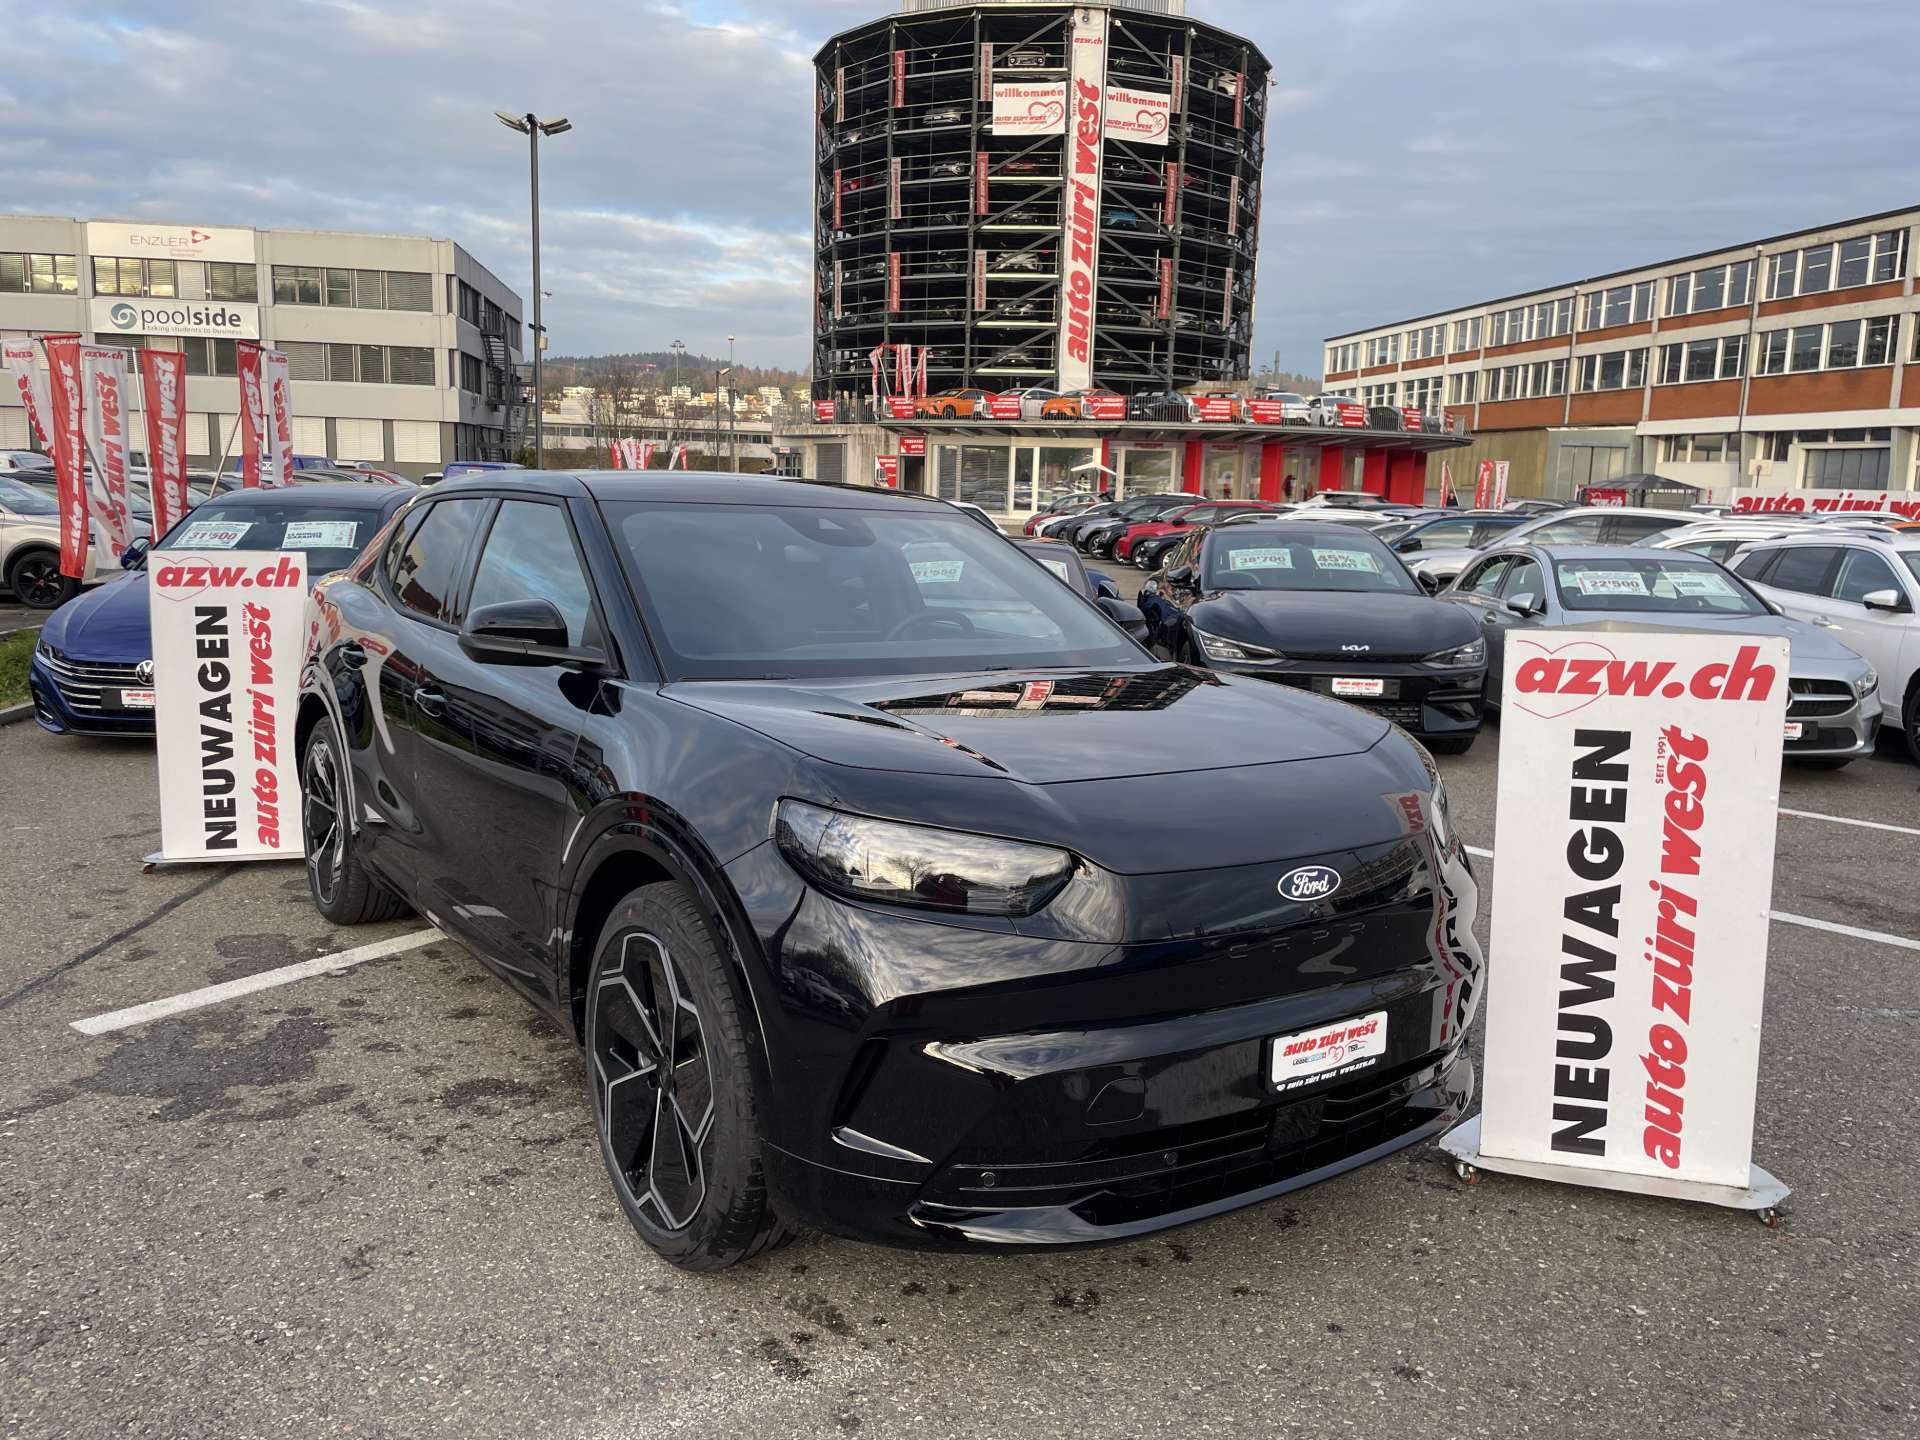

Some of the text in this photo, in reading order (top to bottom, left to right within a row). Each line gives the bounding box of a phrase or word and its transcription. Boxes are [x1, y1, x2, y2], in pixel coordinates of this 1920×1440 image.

[1074, 37, 1103, 45] azw.ch
[994, 88, 1065, 98] willkommen
[1107, 92, 1168, 109] willkommen
[1066, 78, 1100, 363] auto züri west
[130, 235, 189, 247] ENZLER
[141, 306, 242, 331] poolside
[147, 325, 170, 334] taking
[170, 326, 203, 335] students
[212, 328, 243, 336] business
[84, 350, 124, 360] azw.ch
[96, 371, 122, 436] west
[153, 355, 178, 419] west
[158, 420, 180, 481] züri
[100, 437, 126, 499] züri
[1811, 491, 1888, 512] züri
[156, 557, 300, 587] azw.ch
[1589, 580, 1640, 588] 22'500
[1515, 646, 1776, 701] azw.ch
[195, 606, 238, 850] NEUWAGEN
[243, 601, 280, 849] auto züri west
[1655, 736, 1667, 784] SEIT 1991
[1291, 870, 1330, 897] Ford
[1551, 729, 1632, 1156] NEUWAGEN
[1639, 724, 1709, 1170] auto züri west
[1283, 1020, 1378, 1056] auto züri west
[1286, 1080, 1304, 1089] auto
[1304, 1074, 1321, 1085] züri
[1321, 1070, 1337, 1080] west
